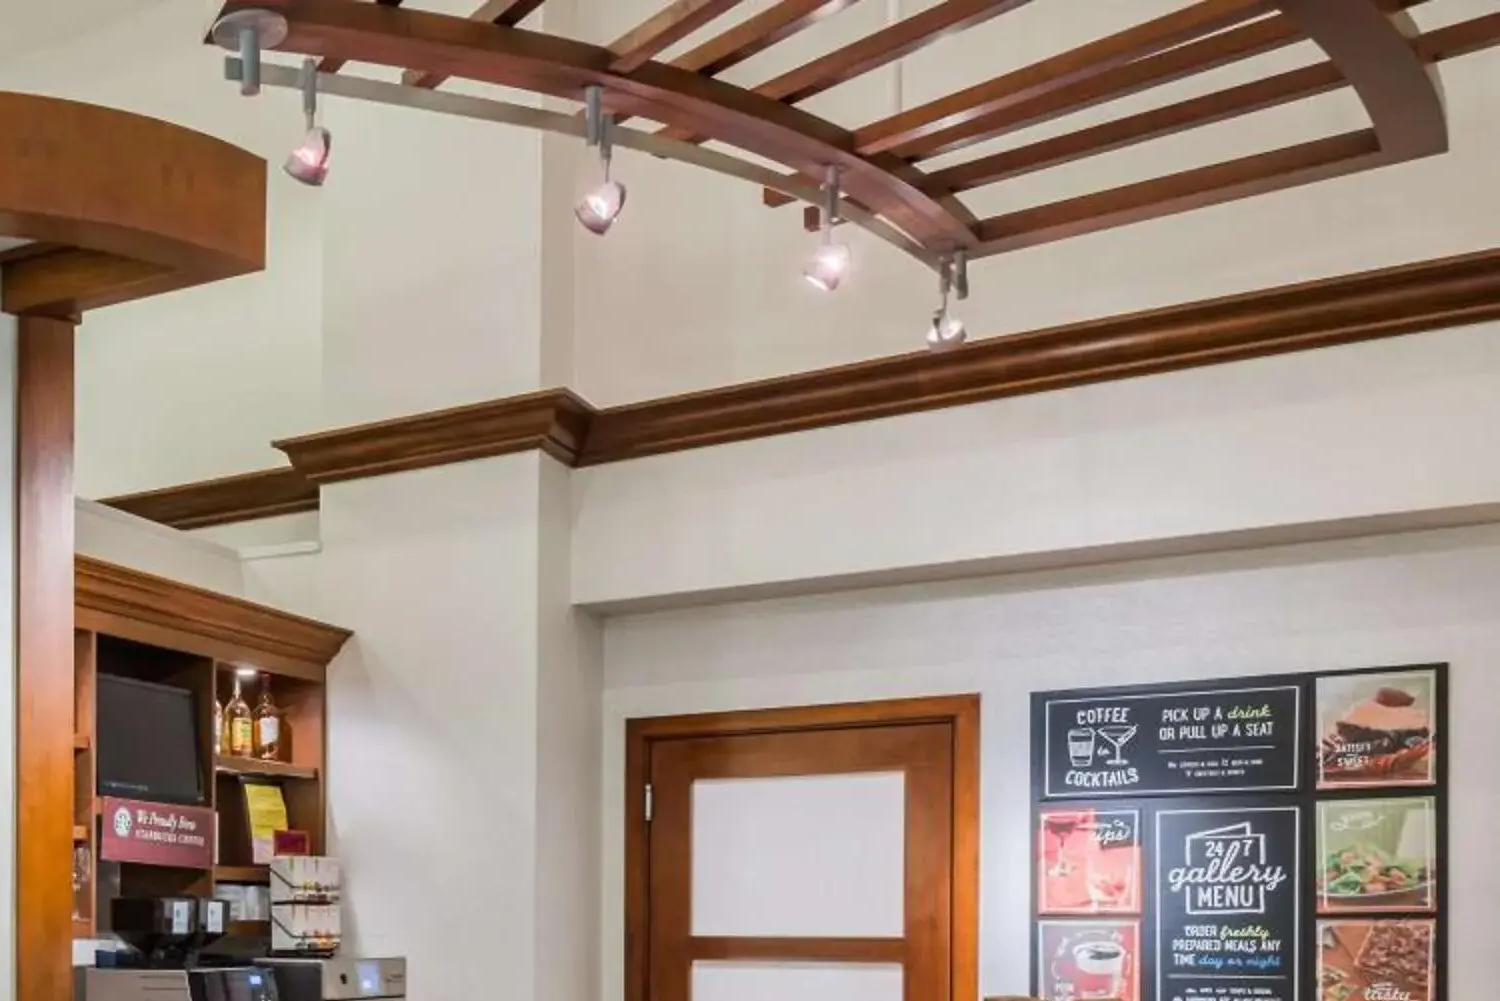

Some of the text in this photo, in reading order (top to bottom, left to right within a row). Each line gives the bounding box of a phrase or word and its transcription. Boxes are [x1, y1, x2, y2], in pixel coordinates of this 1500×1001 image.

[1077, 707, 1131, 725] COFFEE
[1162, 704, 1273, 723] PICK UP A drink
[1159, 721, 1275, 741] OR PULL UP A SEAT
[1065, 768, 1140, 788] COCKTAILS
[1205, 839, 1253, 857] 24 7
[1168, 840, 1287, 892] gallery
[1198, 885, 1254, 908] MENU
[1220, 925, 1270, 941] freshly
[1172, 939, 1282, 953] PREPARED MEALS ANY
[1173, 953, 1197, 966] TIME
[1198, 954, 1224, 970] day
[1246, 954, 1281, 970] night
